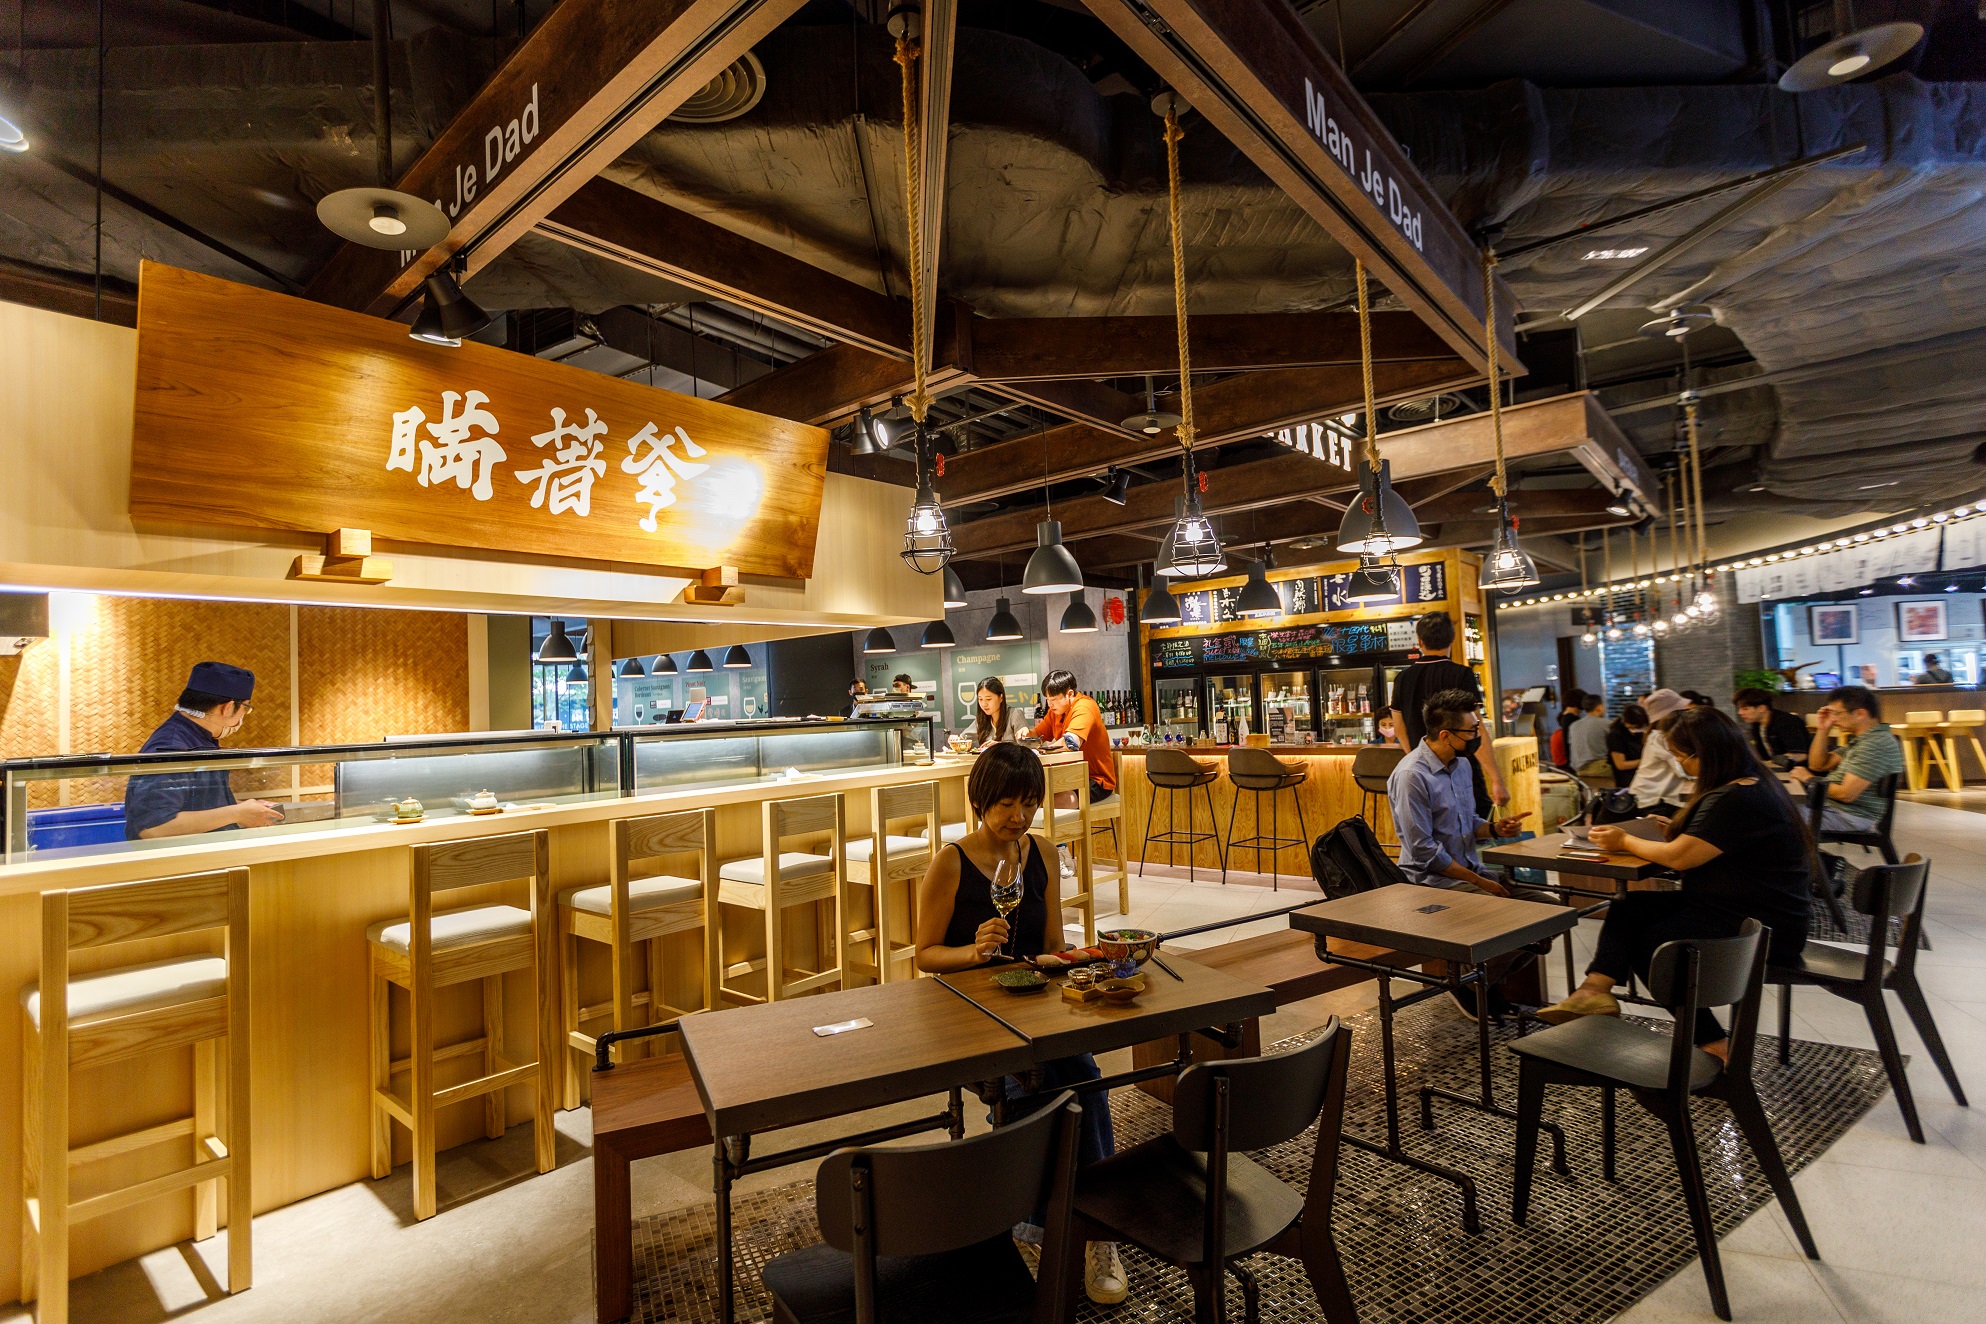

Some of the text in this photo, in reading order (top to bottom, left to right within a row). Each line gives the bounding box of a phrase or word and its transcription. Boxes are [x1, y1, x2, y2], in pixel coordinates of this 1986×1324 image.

[450, 82, 540, 218] Je Dad
[1304, 77, 1424, 252] Man Je Dad
[386, 389, 711, 533] 瞞著爹
[1267, 422, 1352, 472] RKET
[870, 662, 889, 673] Syrah
[956, 653, 1001, 665] Champagne
